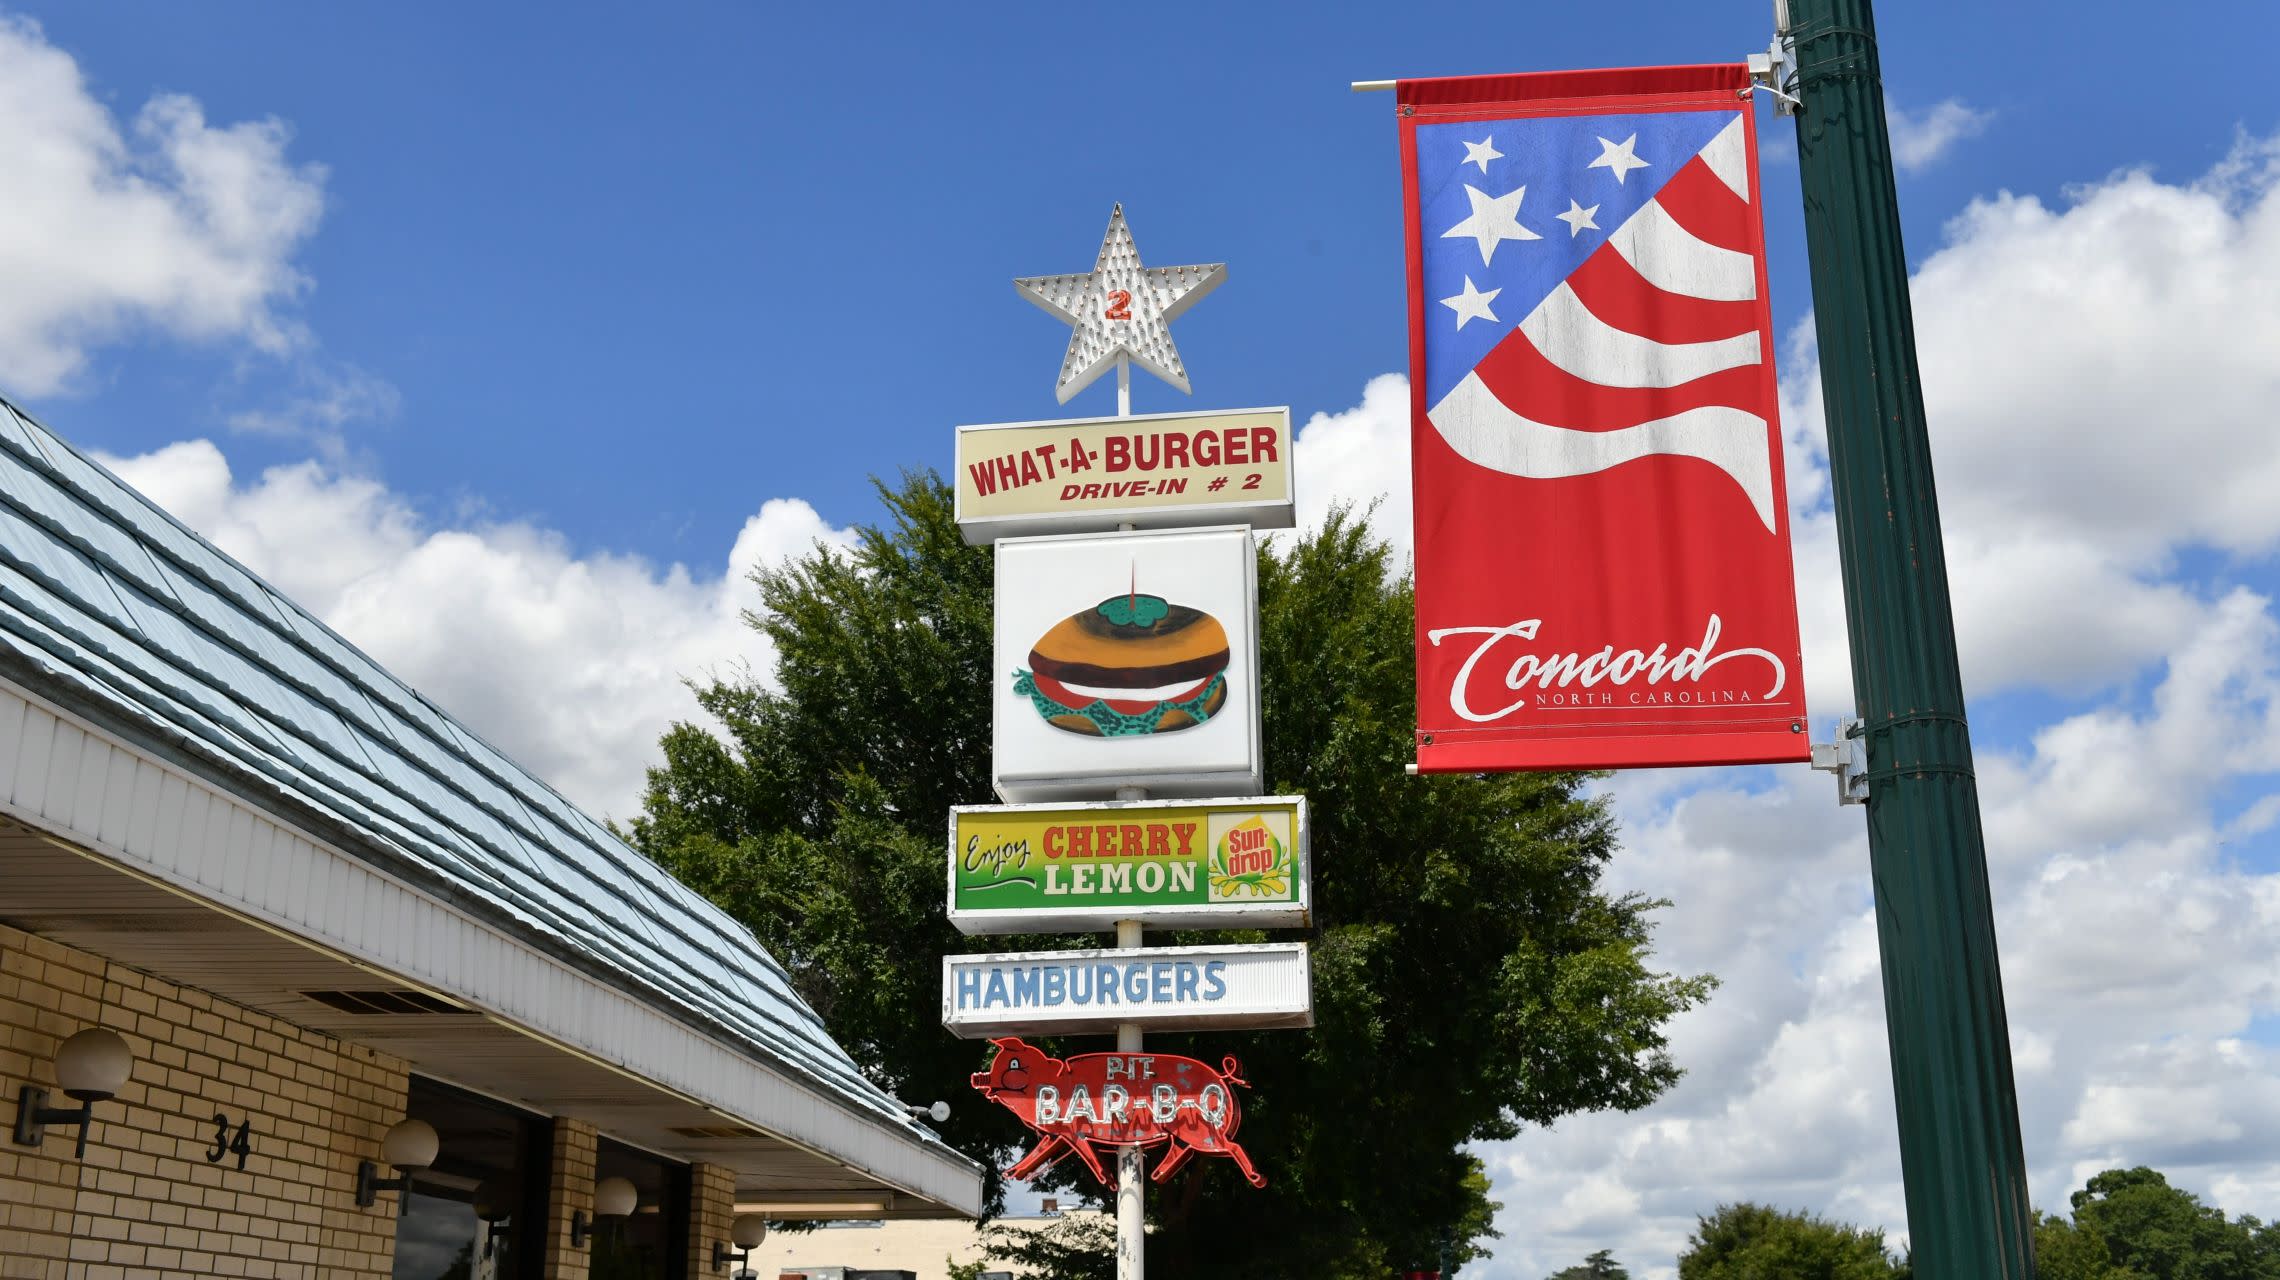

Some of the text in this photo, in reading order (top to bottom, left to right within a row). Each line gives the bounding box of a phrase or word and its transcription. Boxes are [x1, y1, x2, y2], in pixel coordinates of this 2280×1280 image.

[1104, 289, 1132, 321] 2
[1059, 473, 1263, 501] DRIVE-IN # 2
[1427, 613, 1786, 722] Concord
[1535, 690, 1752, 706] NORTH CAROLINA
[964, 833, 1032, 878] Enjoy
[1043, 823, 1197, 859] CHERRY
[1043, 861, 1197, 895] LEMON
[1228, 848, 1273, 877] drop
[957, 960, 1227, 1009] HAMBURGERS
[1106, 1056, 1155, 1080] PIT
[1035, 1083, 1227, 1129] BAR-B-Q
[206, 1113, 252, 1171] 34
